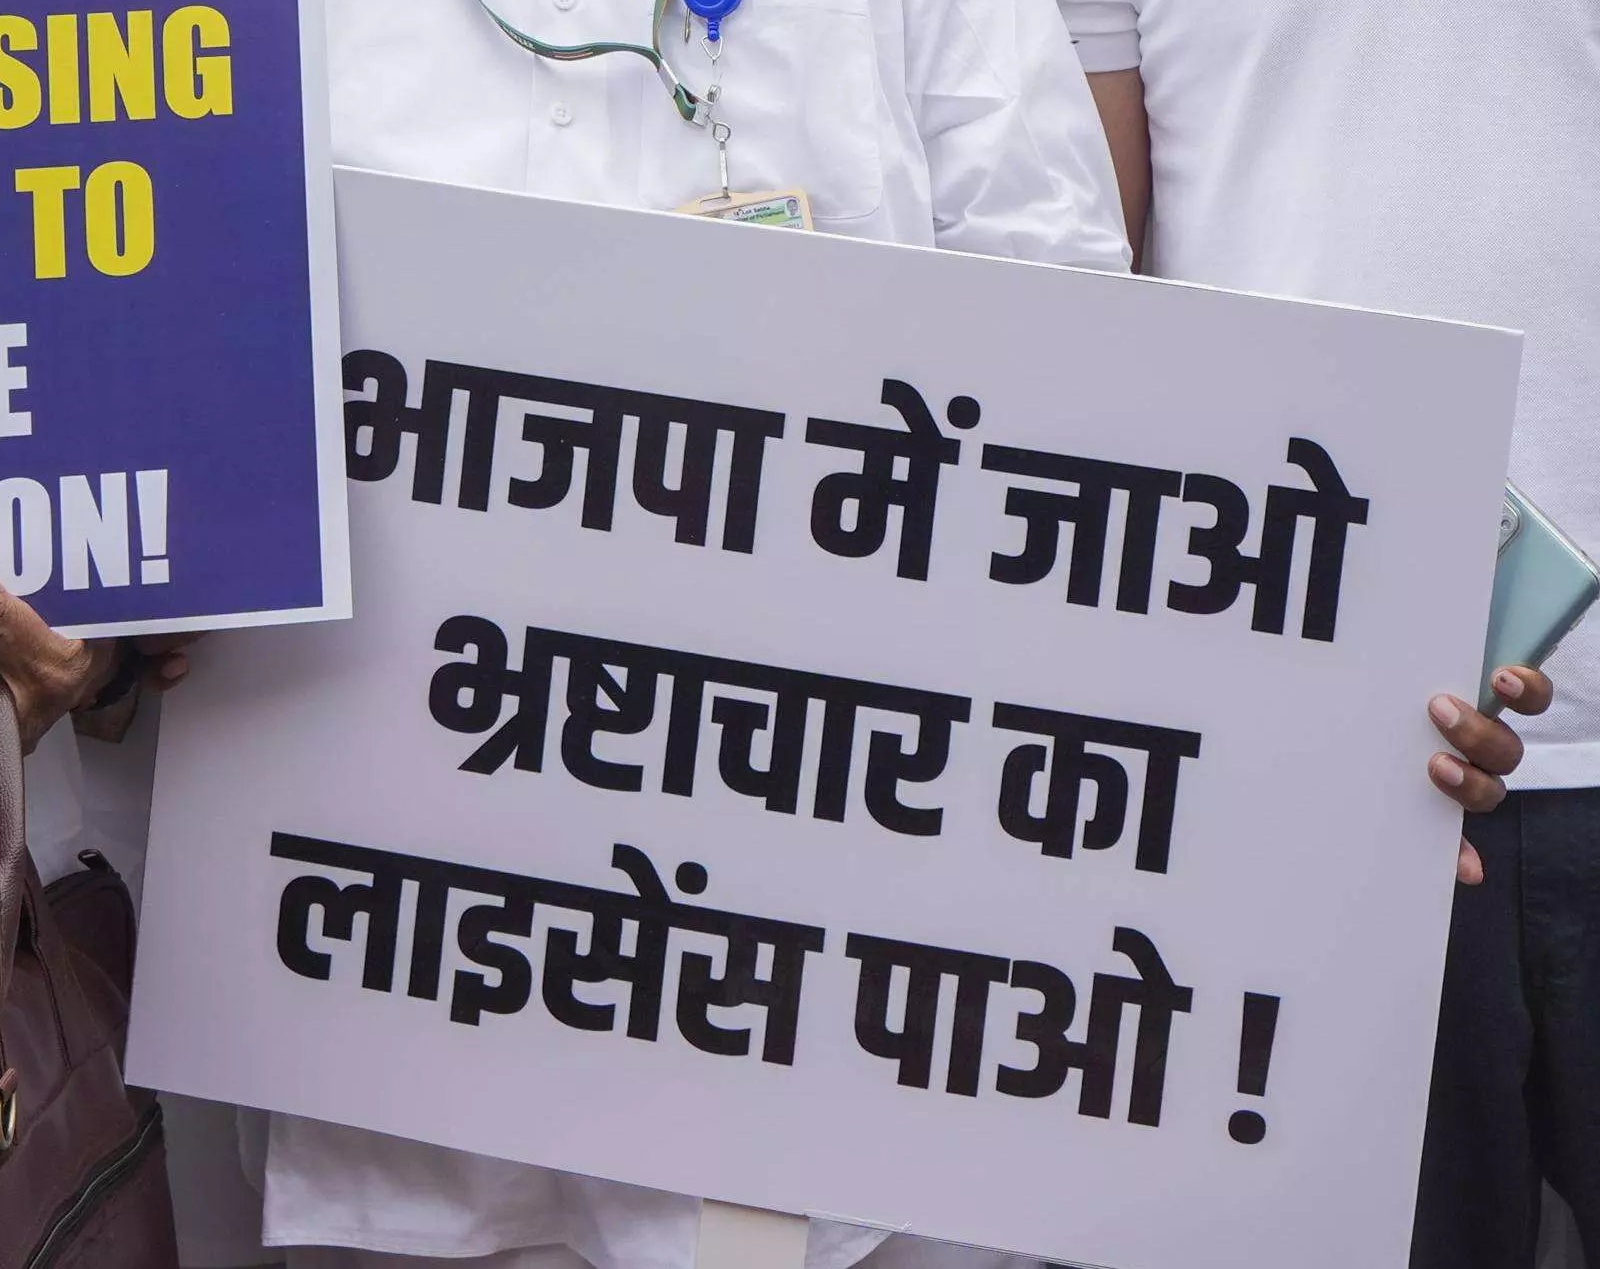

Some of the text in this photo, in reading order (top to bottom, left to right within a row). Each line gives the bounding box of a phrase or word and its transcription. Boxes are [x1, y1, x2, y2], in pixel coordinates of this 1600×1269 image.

[14, 161, 156, 279] TO
[342, 349, 1369, 643] भाजपा में जाओ
[428, 613, 1200, 875] भ्रष्टाचार का
[270, 831, 1281, 1145] लाइसेंस पाओ !
